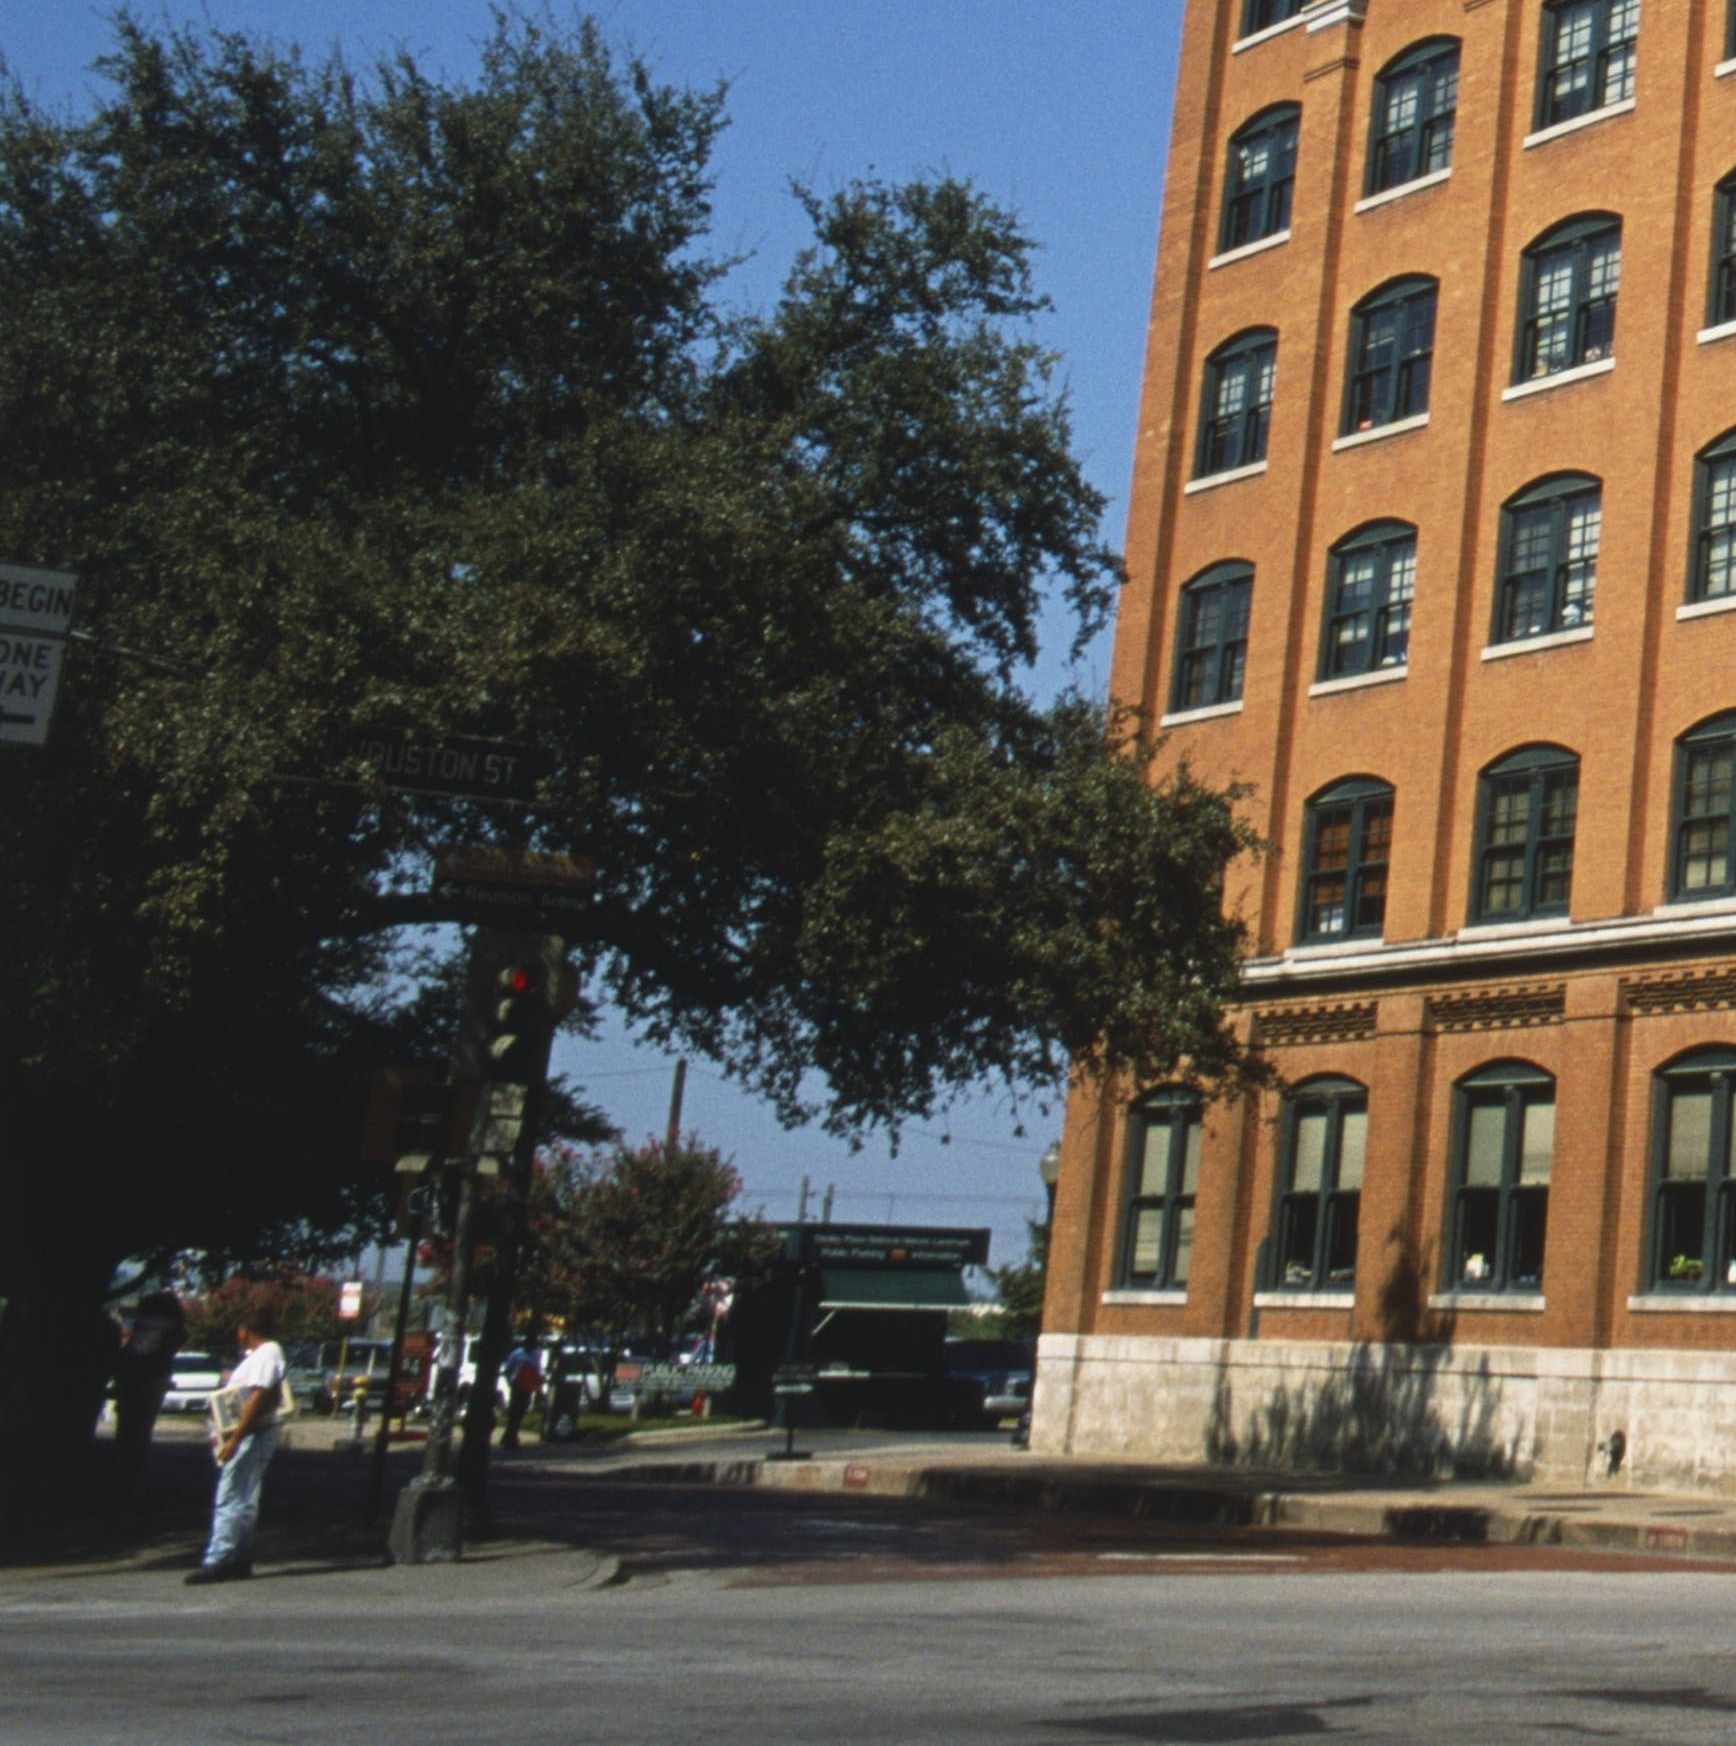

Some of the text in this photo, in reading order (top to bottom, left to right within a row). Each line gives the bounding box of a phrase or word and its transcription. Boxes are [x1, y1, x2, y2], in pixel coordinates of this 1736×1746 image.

[0, 581, 73, 616] BEGIN
[0, 640, 51, 670] ONE
[0, 671, 48, 699] AY
